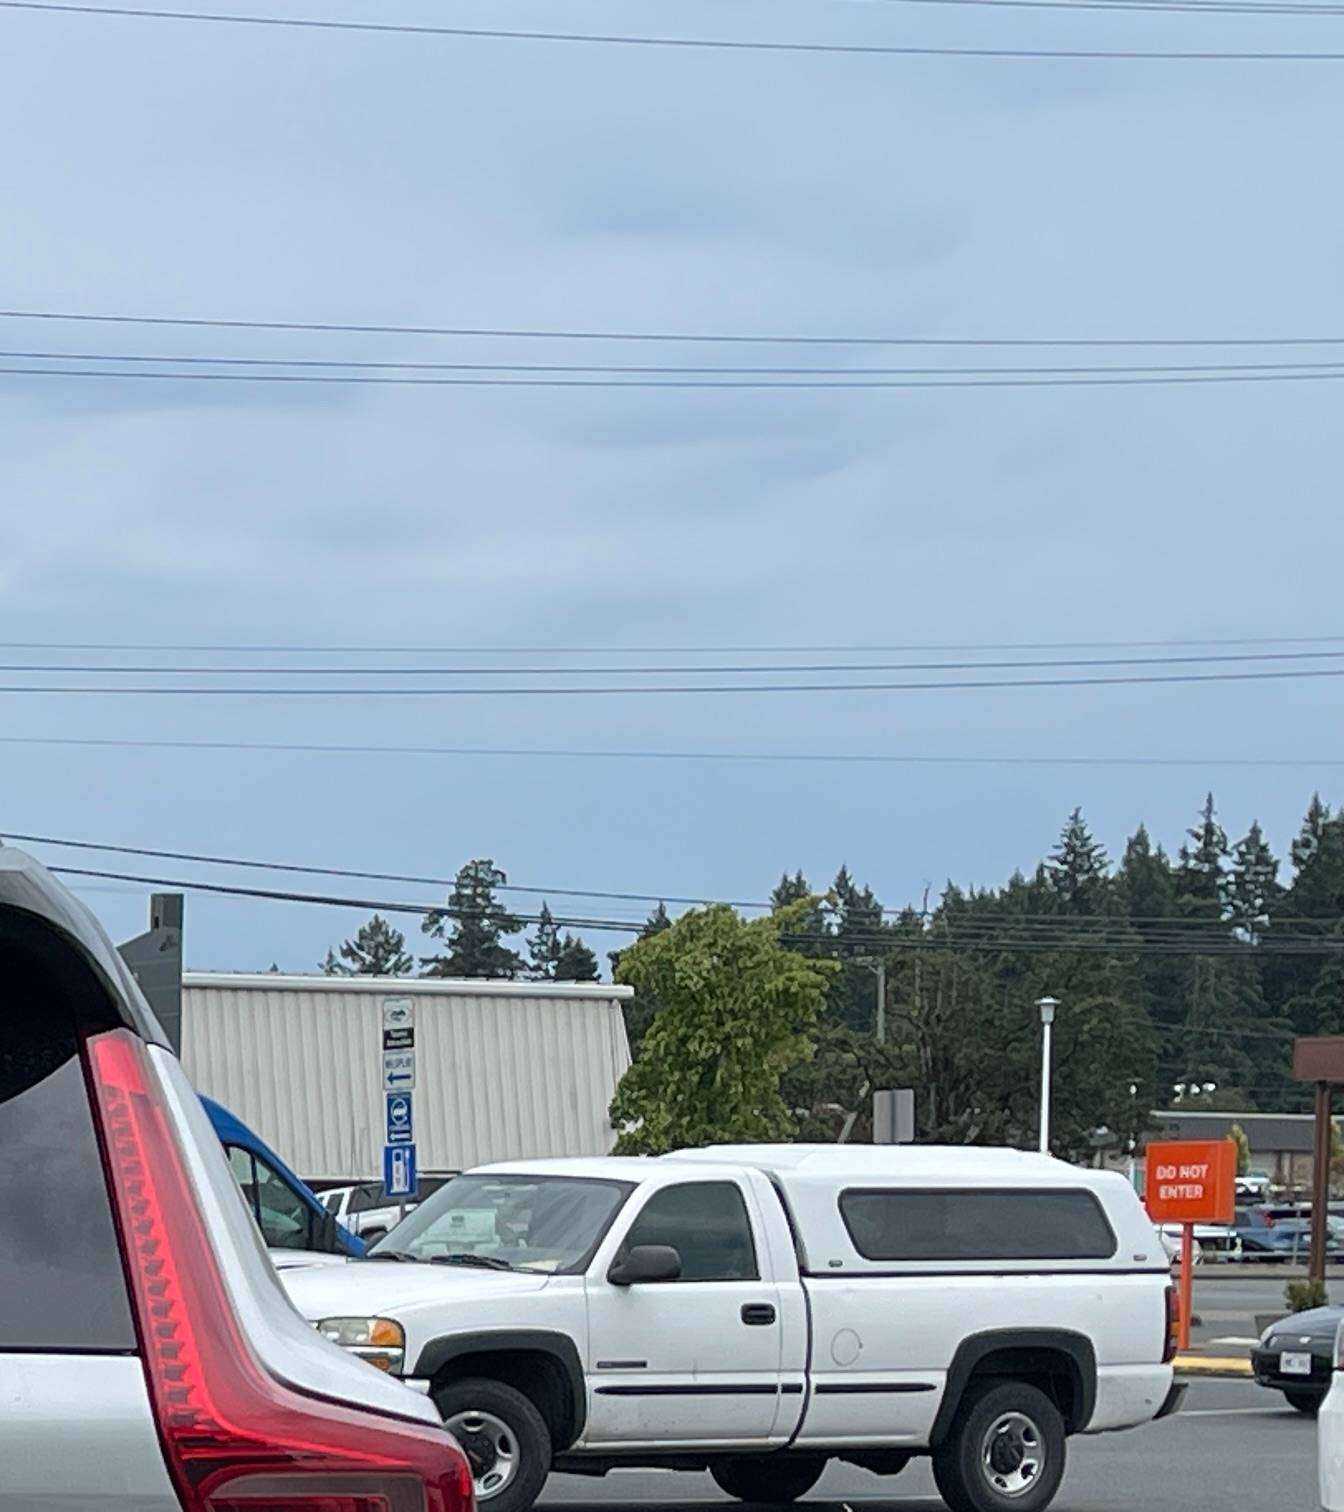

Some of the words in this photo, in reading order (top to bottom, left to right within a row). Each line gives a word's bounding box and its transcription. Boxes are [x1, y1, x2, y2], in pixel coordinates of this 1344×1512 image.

[1155, 1164, 1177, 1180] DO
[1178, 1163, 1209, 1179] NOT
[1158, 1184, 1204, 1200] ENTER
